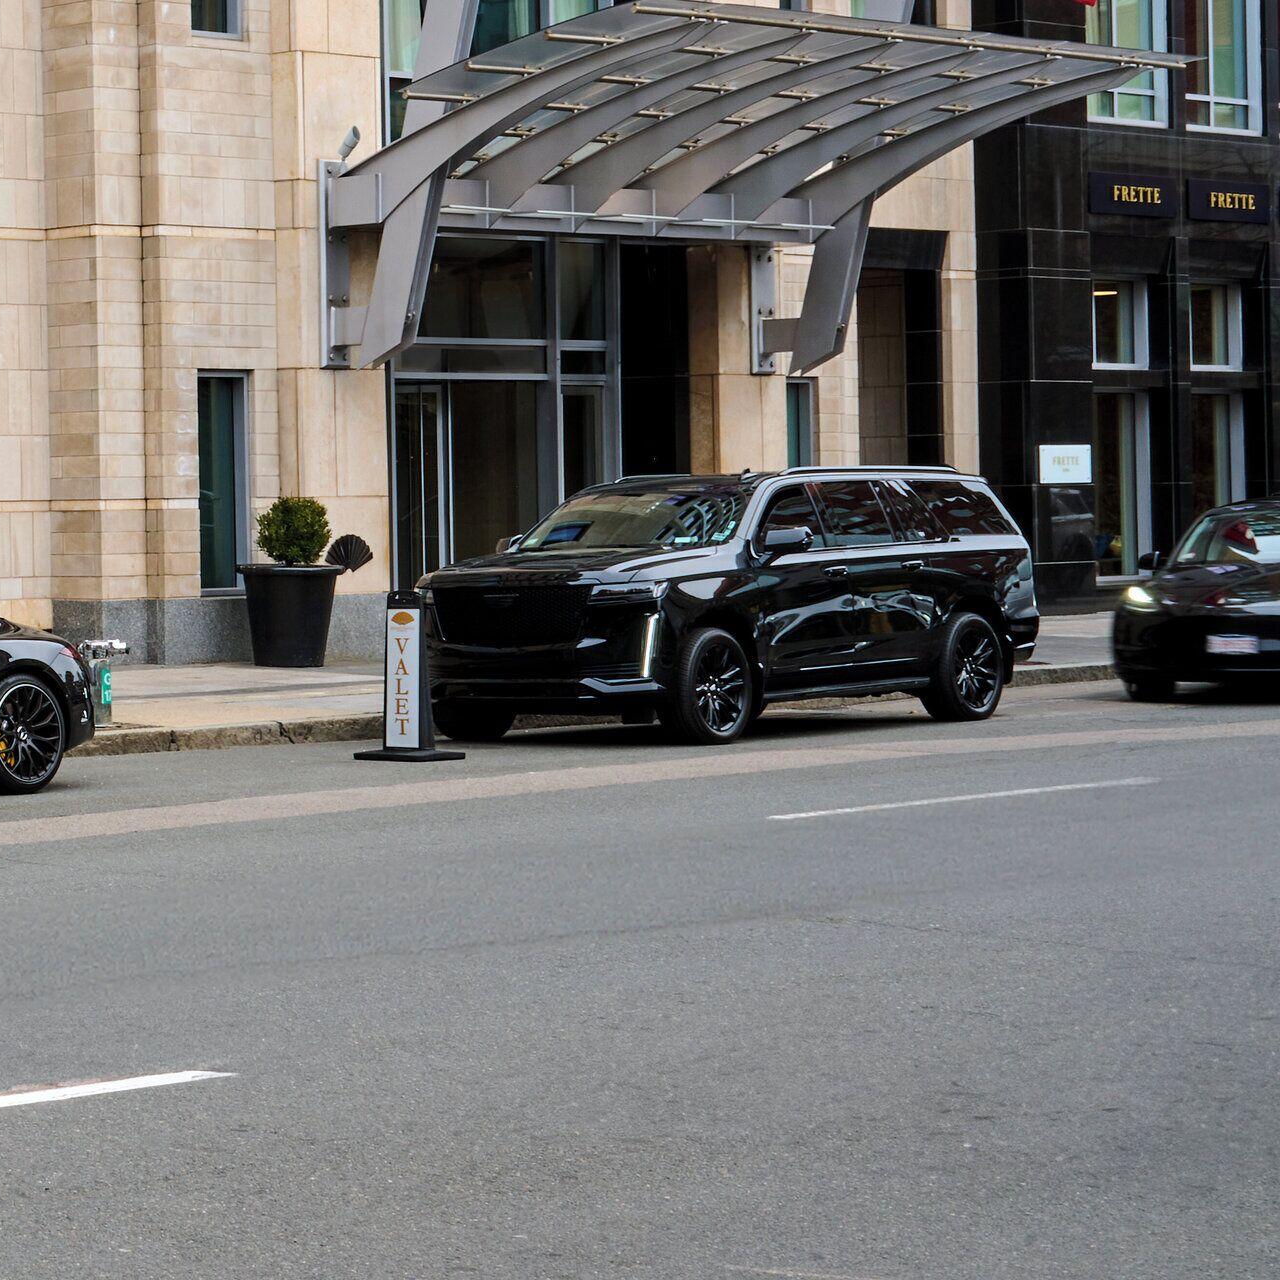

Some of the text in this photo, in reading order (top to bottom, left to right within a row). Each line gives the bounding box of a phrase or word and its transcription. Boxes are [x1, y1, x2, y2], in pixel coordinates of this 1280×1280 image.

[1113, 184, 1162, 205] FRETTE
[1209, 191, 1256, 211] FRETTE
[393, 637, 410, 736] VALET
